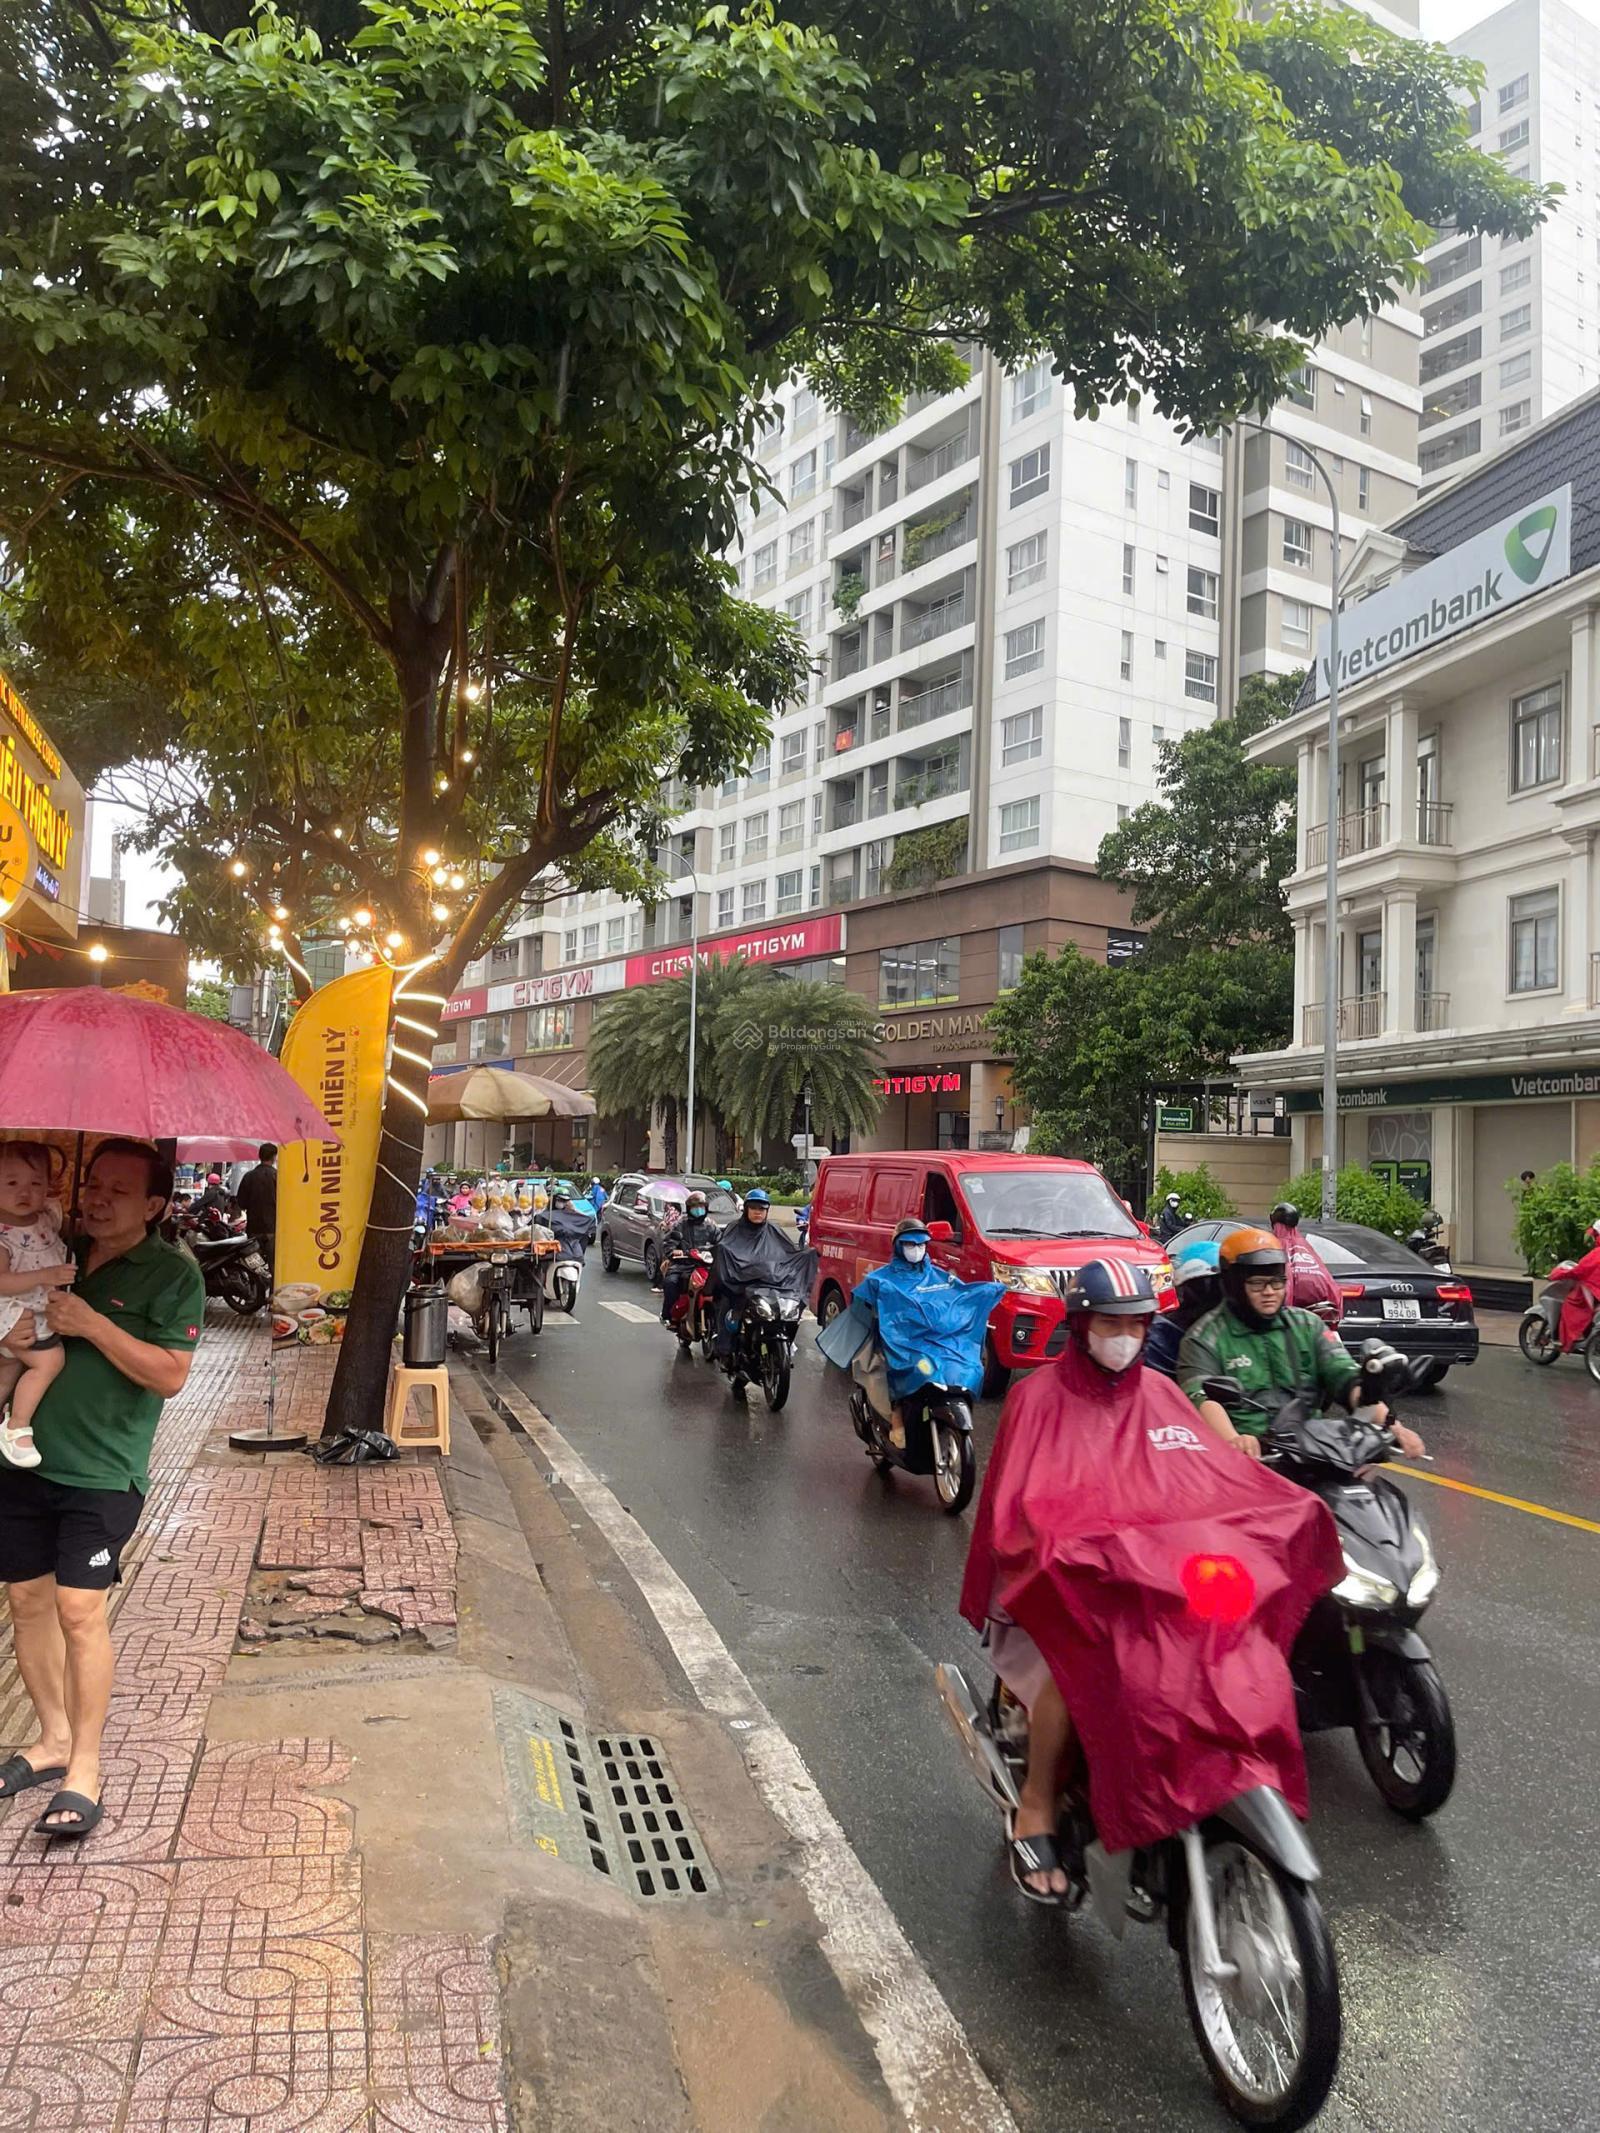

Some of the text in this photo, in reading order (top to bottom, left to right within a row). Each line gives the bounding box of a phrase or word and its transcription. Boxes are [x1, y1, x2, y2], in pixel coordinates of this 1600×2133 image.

[1323, 568, 1503, 689] Vietcombank
[737, 933, 805, 960] CITIGYM
[652, 952, 709, 976] CITIGYM
[513, 969, 594, 1006] CITIGYM
[321, 1027, 346, 1053] LÝ
[873, 1019, 946, 1043] GOLDEN
[872, 1073, 961, 1096] CITIGYM
[1393, 1301, 1409, 1309] 51L
[189, 1328, 197, 1336] H
